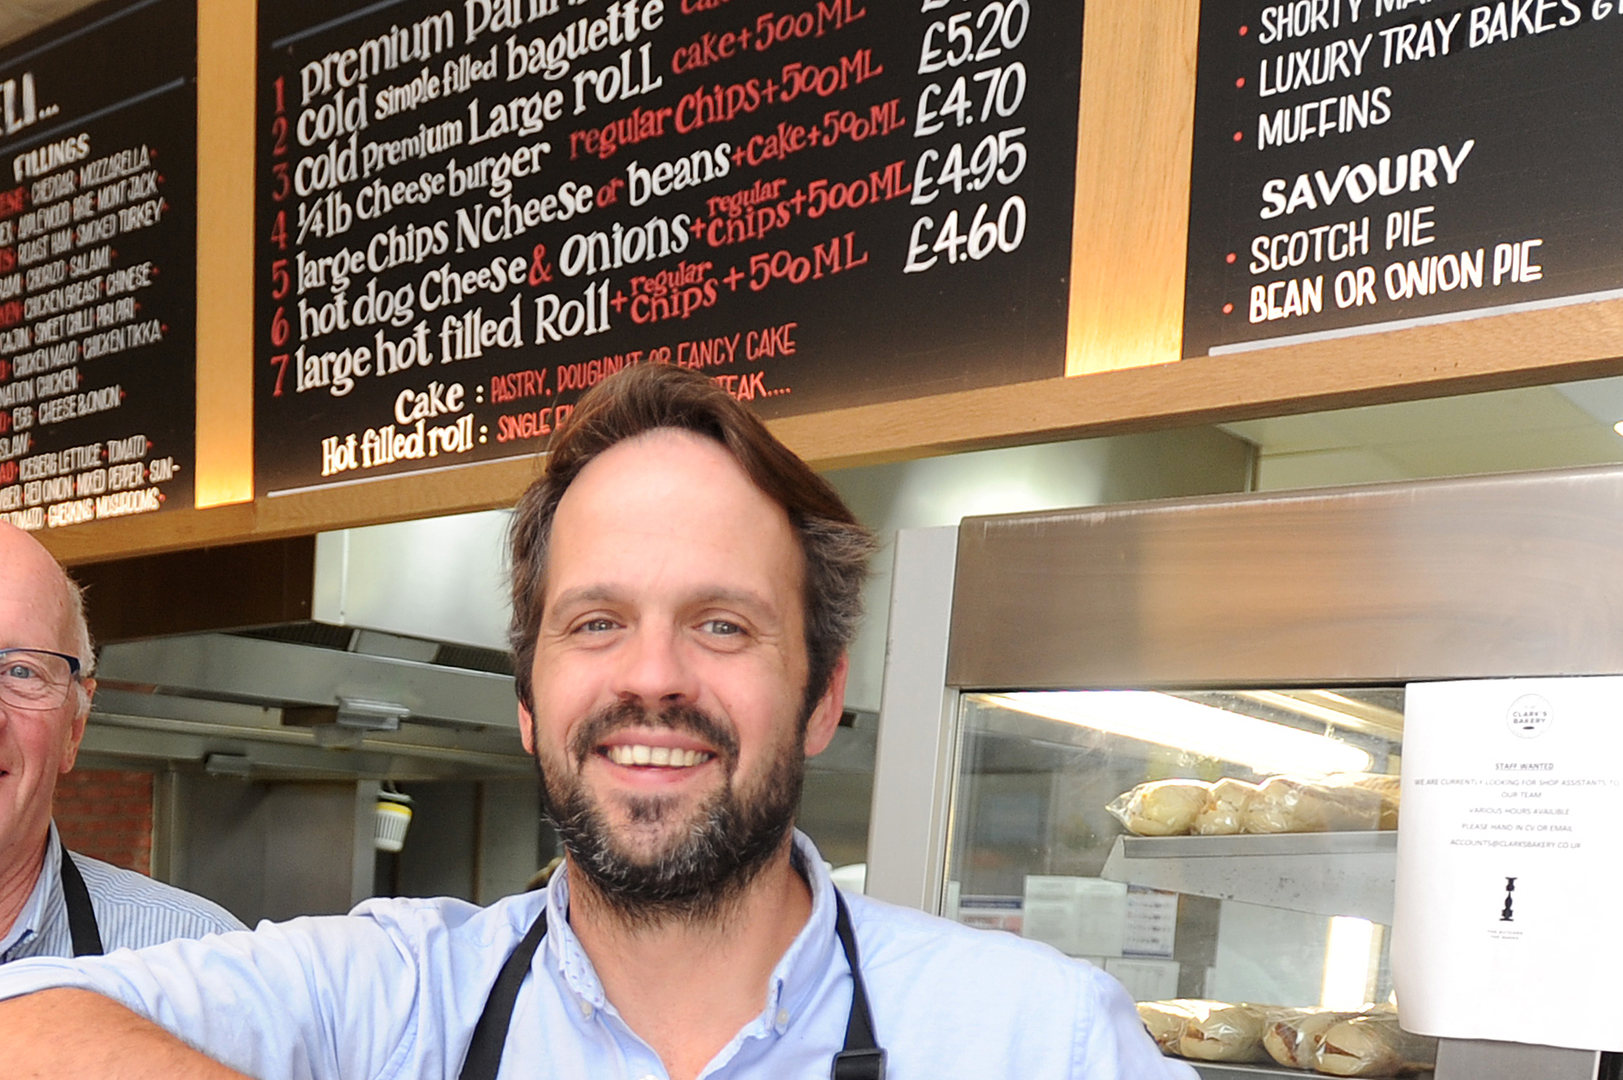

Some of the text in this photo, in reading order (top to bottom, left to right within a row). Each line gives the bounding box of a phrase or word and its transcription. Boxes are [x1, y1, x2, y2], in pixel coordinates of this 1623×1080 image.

[273, 75, 286, 115] 1
[300, 10, 454, 107] premium
[1259, 0, 1364, 44] SHORTY
[1259, 0, 1581, 97] LUXURY TRAY BAKES
[272, 0, 665, 156] 2 cold simple filled baguette
[1258, 86, 1392, 151] MUFFINS
[13, 133, 90, 183] FILLINGS
[270, 210, 288, 250] 4
[446, 141, 552, 198] burger
[569, 105, 673, 161] regular
[917, 0, 1030, 75] £5.20
[272, 161, 290, 202] 3
[294, 130, 359, 197] cold
[361, 119, 463, 178] premium
[467, 89, 564, 146] Large
[271, 258, 290, 300] 5
[295, 246, 366, 296] large
[597, 177, 625, 208] or
[626, 142, 731, 206] beans
[913, 61, 1027, 138] £4.70
[1260, 139, 1475, 220] SAVOURY
[270, 306, 290, 347] 6
[297, 290, 350, 341] hot
[352, 276, 415, 327] dog
[529, 243, 553, 287] &
[706, 177, 787, 219] regular
[910, 126, 1027, 206] £4.95
[1249, 205, 1435, 275] SCOTCH PIE
[270, 353, 290, 397] 7
[294, 343, 372, 396] large
[375, 319, 434, 377] hot
[439, 292, 524, 365] filled
[535, 278, 612, 345] Roll
[630, 260, 713, 297] regular
[903, 194, 1026, 274] £4.60
[1248, 238, 1544, 325] BEAN OR ONION PIE
[677, 333, 741, 369] FANCY
[746, 322, 797, 361] CAKE
[321, 434, 359, 477] Hot
[360, 417, 425, 470] filled
[428, 412, 475, 458] roll
[496, 405, 553, 442] SINGLE
[1495, 762, 1554, 770] STAFF WANTED
[1521, 778, 1537, 786] FOR
[1461, 823, 1488, 831] PLEASE
